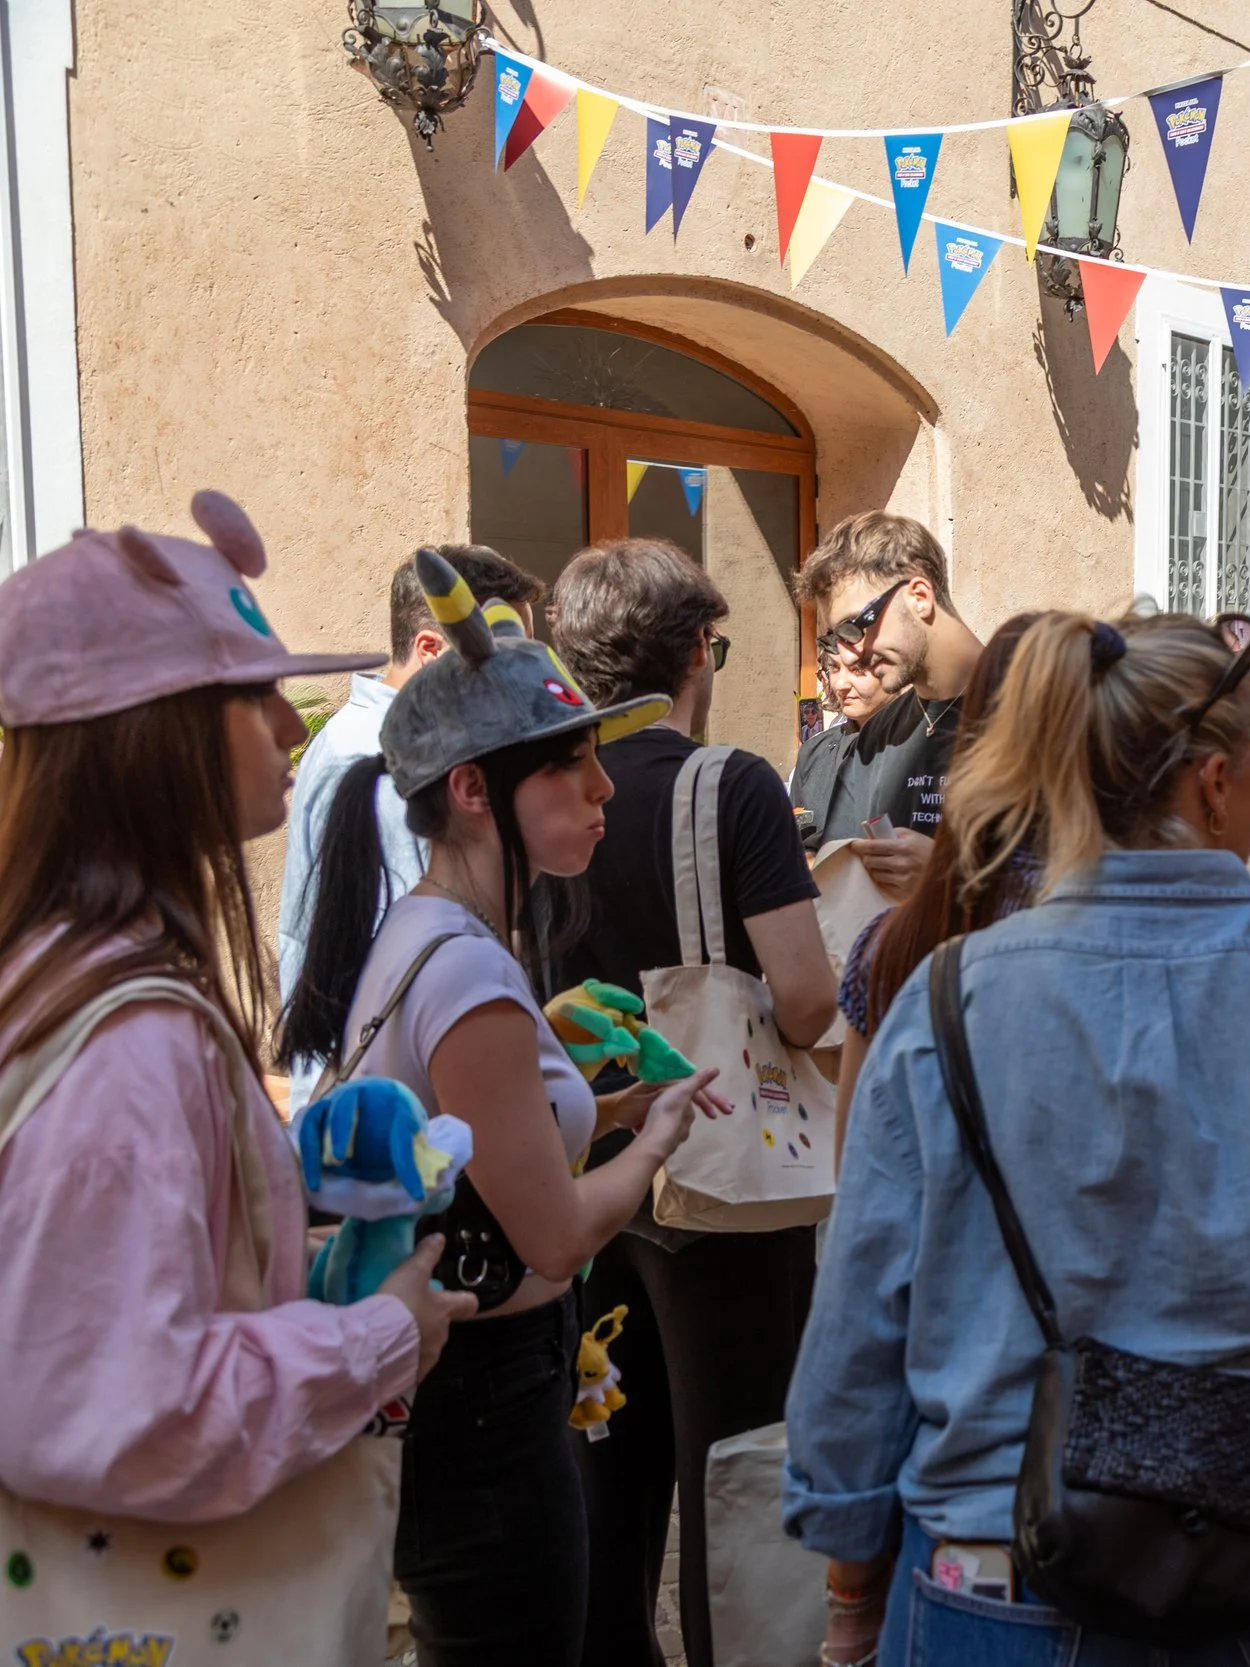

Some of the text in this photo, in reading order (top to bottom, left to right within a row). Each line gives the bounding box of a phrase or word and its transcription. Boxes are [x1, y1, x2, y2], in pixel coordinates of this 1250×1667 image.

[907, 775, 933, 787] DON'T
[921, 793, 945, 805] WITH
[912, 812, 942, 823] TECHN
